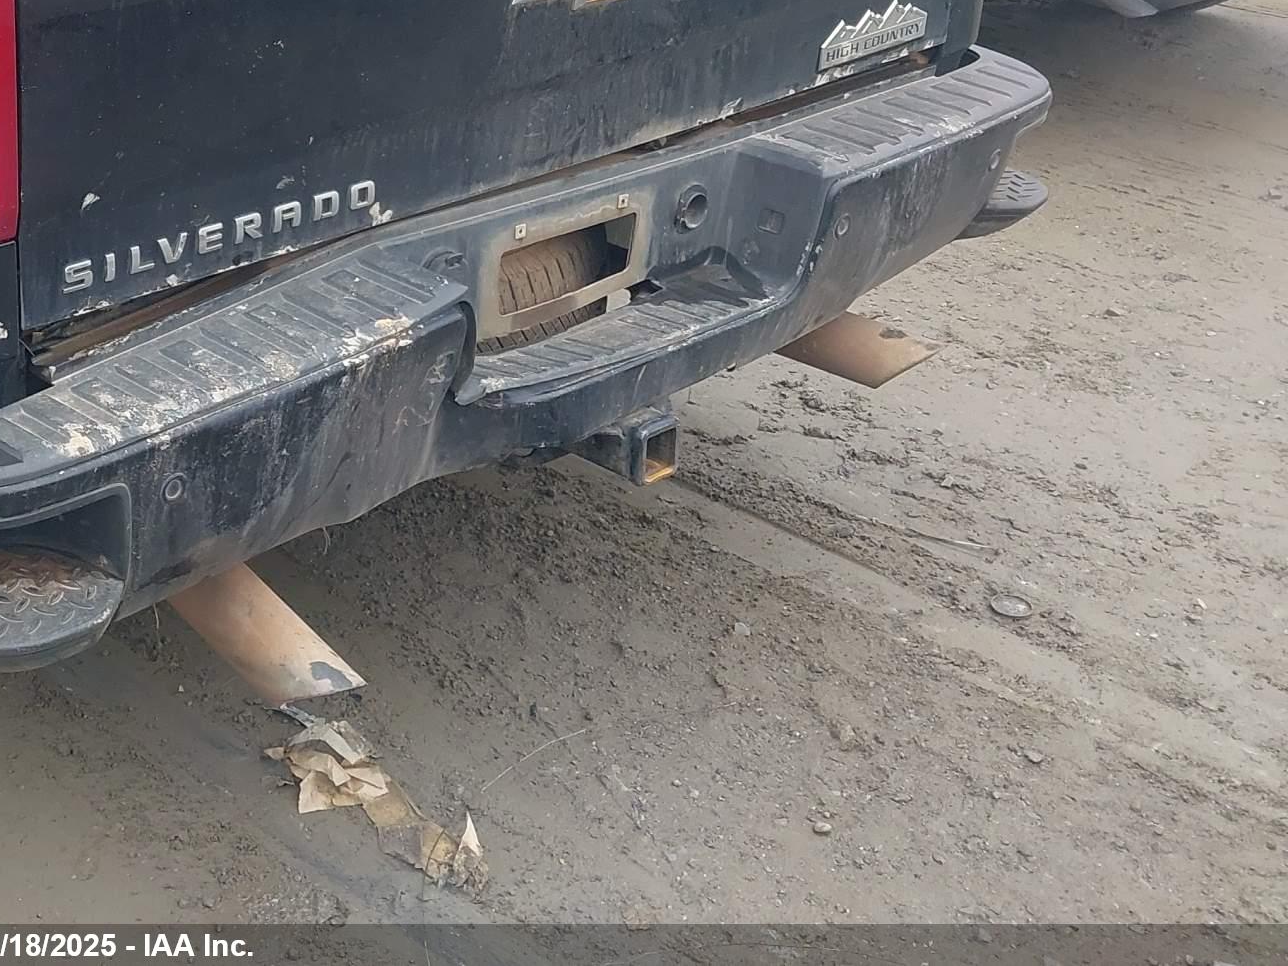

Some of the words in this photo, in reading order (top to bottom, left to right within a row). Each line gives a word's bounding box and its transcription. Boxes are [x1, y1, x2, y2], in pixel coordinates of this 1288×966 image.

[825, 43, 859, 62] HIGH
[863, 21, 923, 50] COUNTRY
[62, 178, 378, 294] SILVERADO
